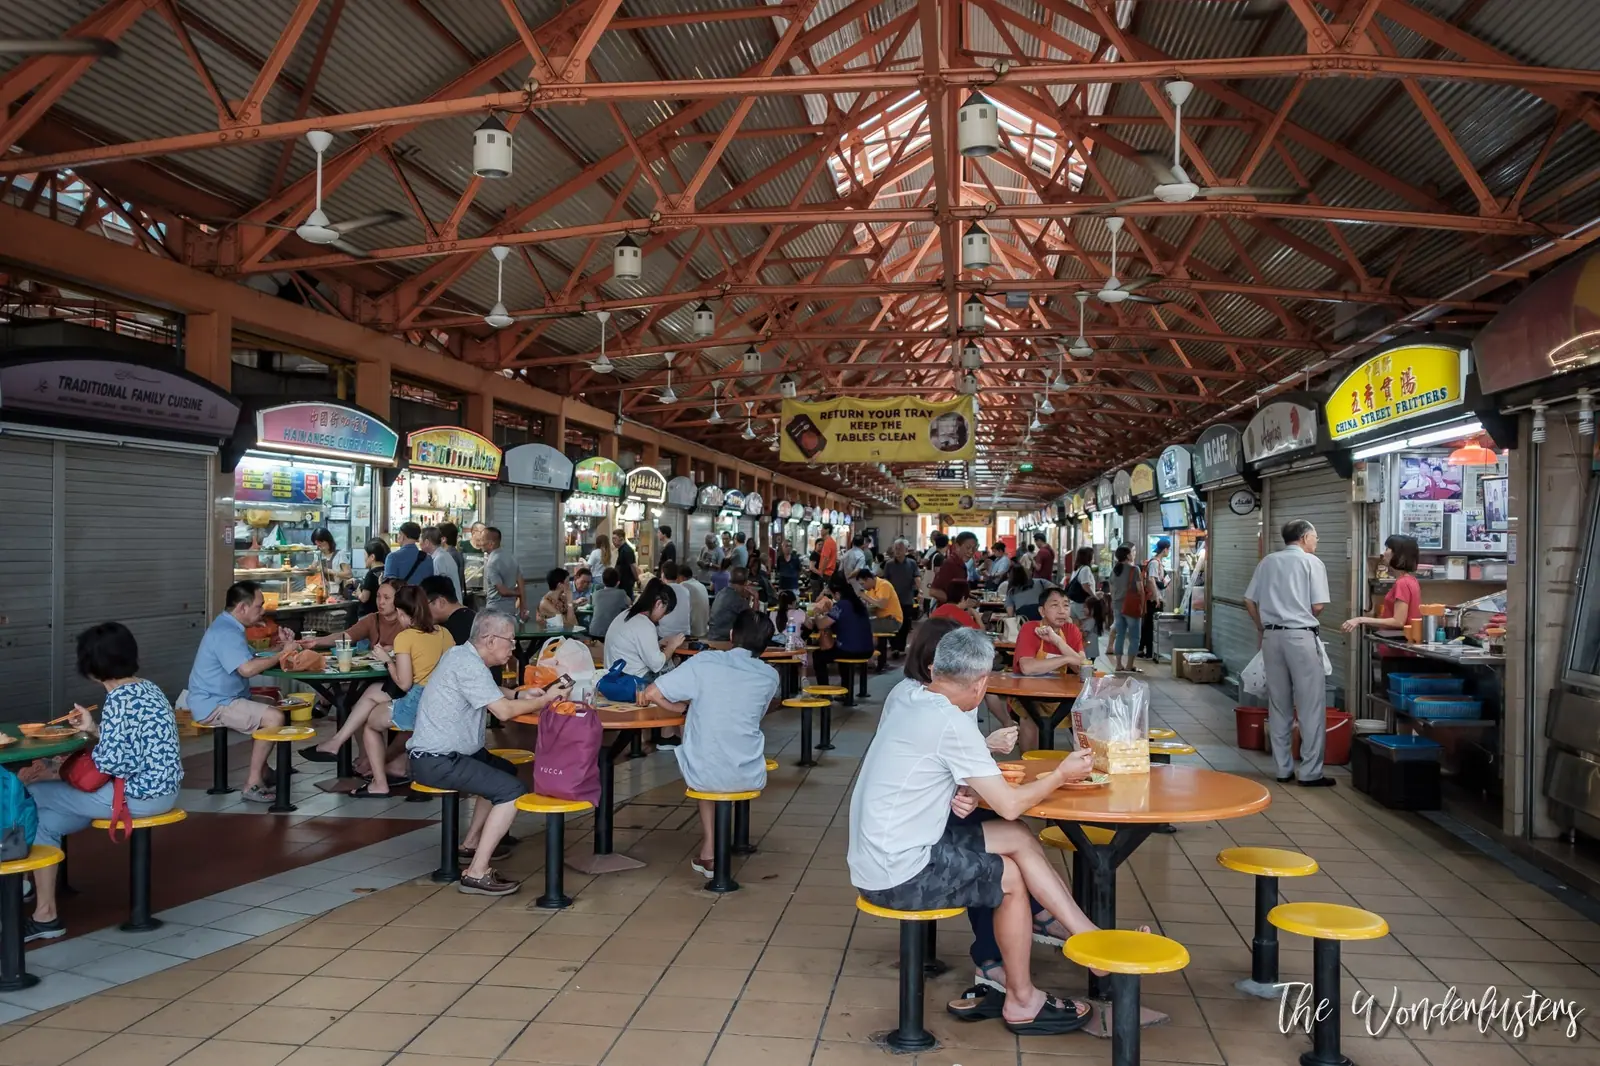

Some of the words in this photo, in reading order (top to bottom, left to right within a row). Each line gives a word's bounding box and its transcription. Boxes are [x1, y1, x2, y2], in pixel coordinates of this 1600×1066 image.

[58, 375, 128, 400] TRADITIONAL
[131, 389, 166, 406] FAMILY
[168, 394, 203, 411] CUISINE
[820, 409, 864, 420] RETURN
[868, 408, 901, 419] YOUR
[904, 408, 934, 419] TRAY
[1335, 419, 1358, 433] CHINA
[1360, 406, 1391, 425] STREET
[1395, 387, 1448, 414] FRITTERS
[850, 421, 878, 430] KEEP
[881, 420, 902, 430] THE
[283, 427, 335, 447] HAINANESE
[337, 437, 363, 451] CURRY
[835, 432, 875, 442] TABLES
[879, 432, 916, 442] CLEAN
[540, 767, 563, 775] YUCCA
